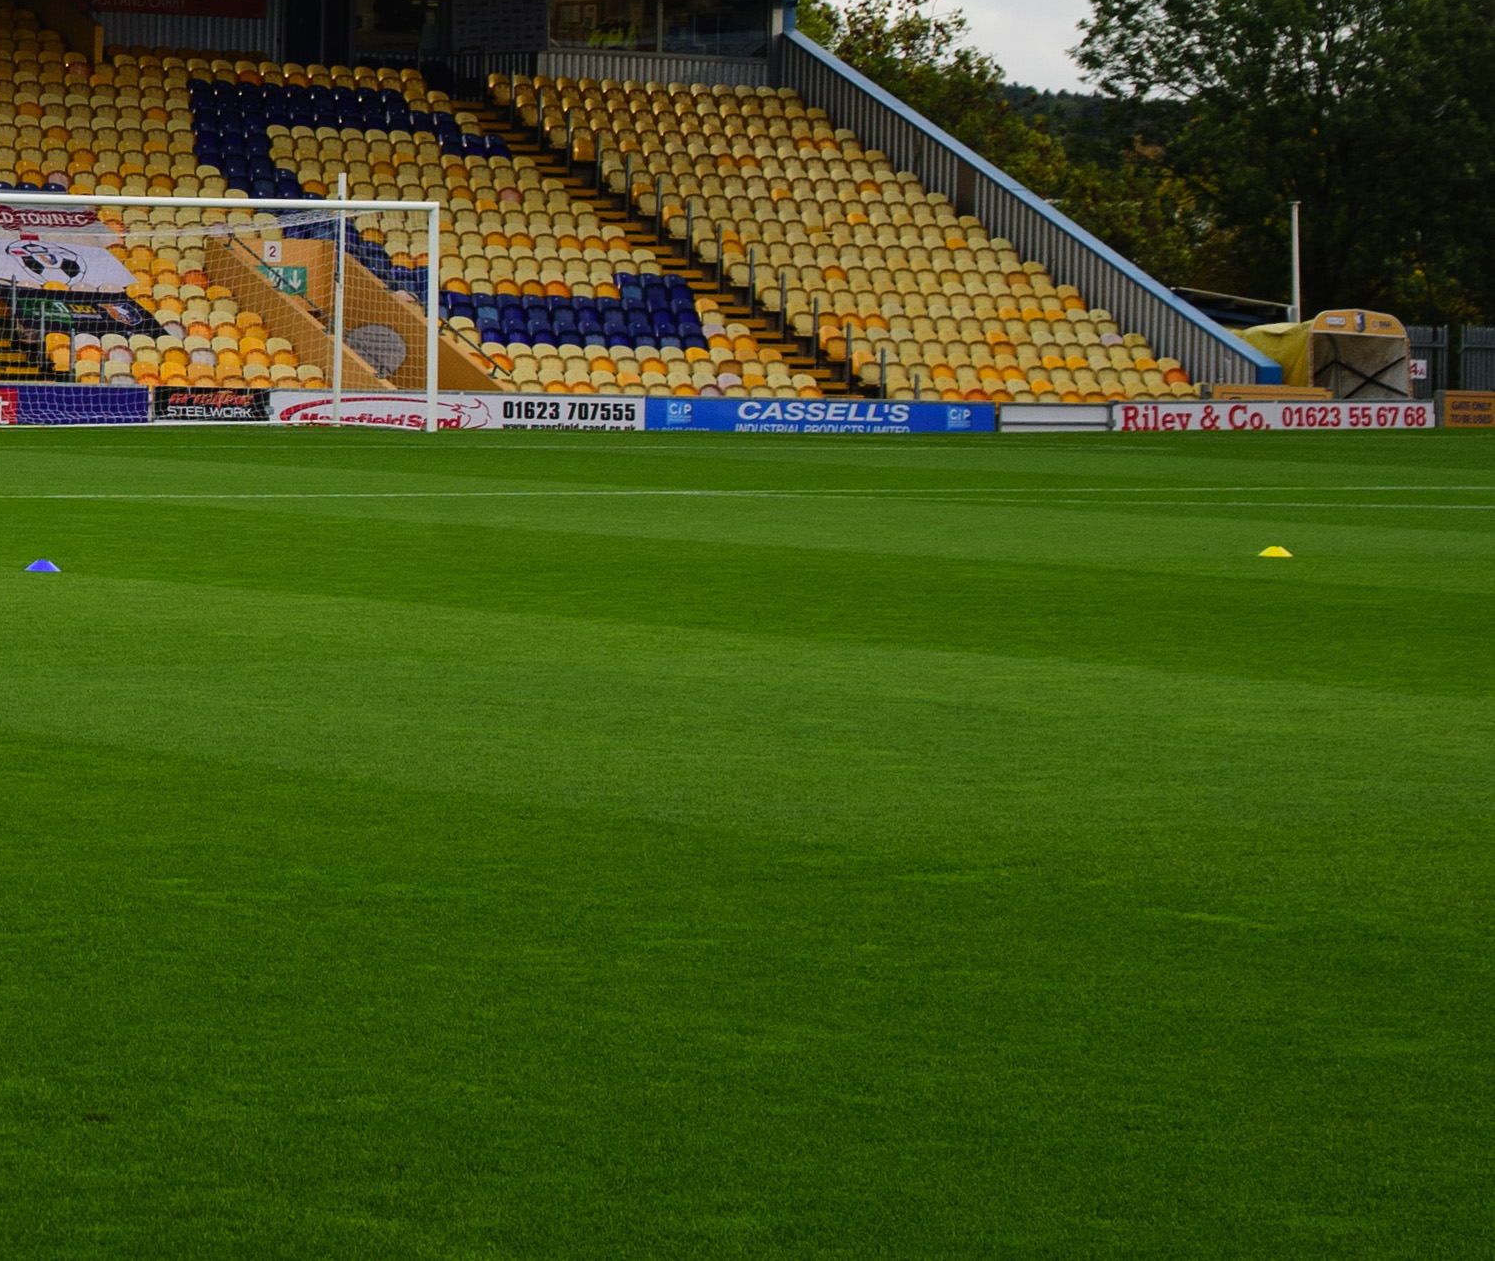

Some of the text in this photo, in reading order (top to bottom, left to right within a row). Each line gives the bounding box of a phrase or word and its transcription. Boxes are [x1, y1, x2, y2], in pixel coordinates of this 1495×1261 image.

[268, 245, 278, 257] 2
[167, 405, 253, 418] STEELWORK
[503, 401, 635, 420] 01623 707555
[737, 401, 910, 423] CASSELL'S
[1200, 405, 1220, 429] &
[1228, 404, 1271, 429] Co.
[1282, 406, 1340, 427] 01623
[1349, 407, 1372, 427] 55
[1376, 407, 1400, 427] 67
[1404, 406, 1426, 426] 68
